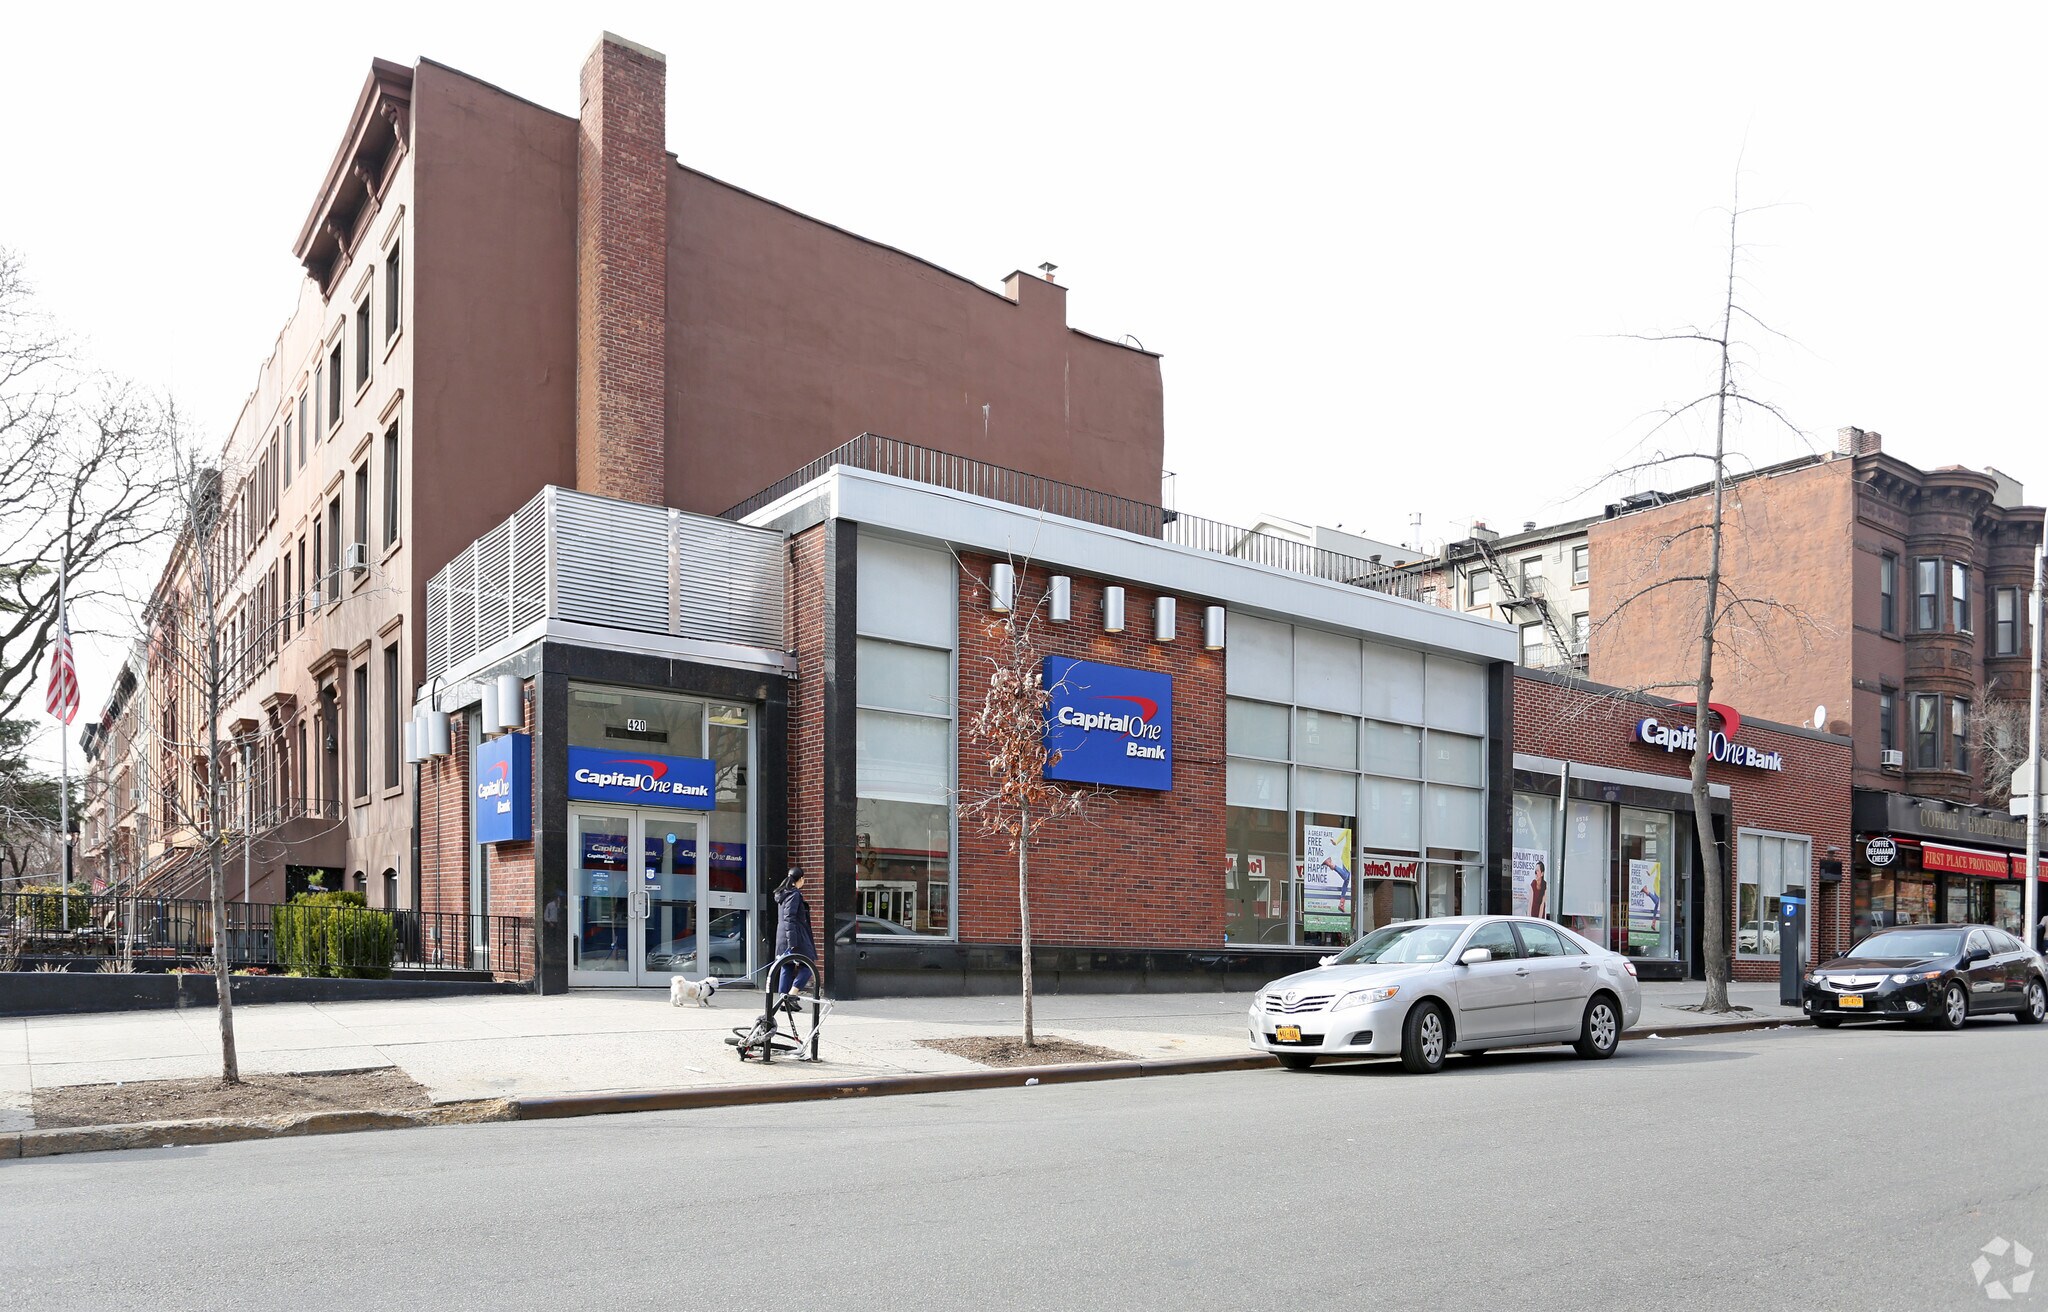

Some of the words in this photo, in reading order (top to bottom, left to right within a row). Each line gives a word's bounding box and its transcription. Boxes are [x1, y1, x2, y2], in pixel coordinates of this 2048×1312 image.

[628, 719, 646, 731] 420
[1126, 741, 1166, 760] Bank
[1746, 747, 1782, 771] Bank
[672, 782, 709, 796] Bank
[497, 799, 511, 814] Bank
[1920, 808, 1959, 831] COFFEE
[1308, 837, 1322, 847] FREE
[1308, 847, 1324, 857] ATMs
[1513, 851, 1531, 861] UNLIMIT
[1531, 853, 1544, 862] YOUR
[1308, 863, 1328, 873] HAPPY
[1513, 861, 1535, 870] BUSINESS
[1925, 851, 1945, 866] FIRST
[1946, 853, 1968, 869] PLACE
[1969, 857, 2006, 874] PROVISIONS
[1308, 873, 1328, 883] DANCE
[1631, 868, 1641, 877] FREE
[1631, 890, 1645, 899] HAPPY
[1631, 899, 1645, 907] DANCE
[1786, 904, 1794, 915] P
